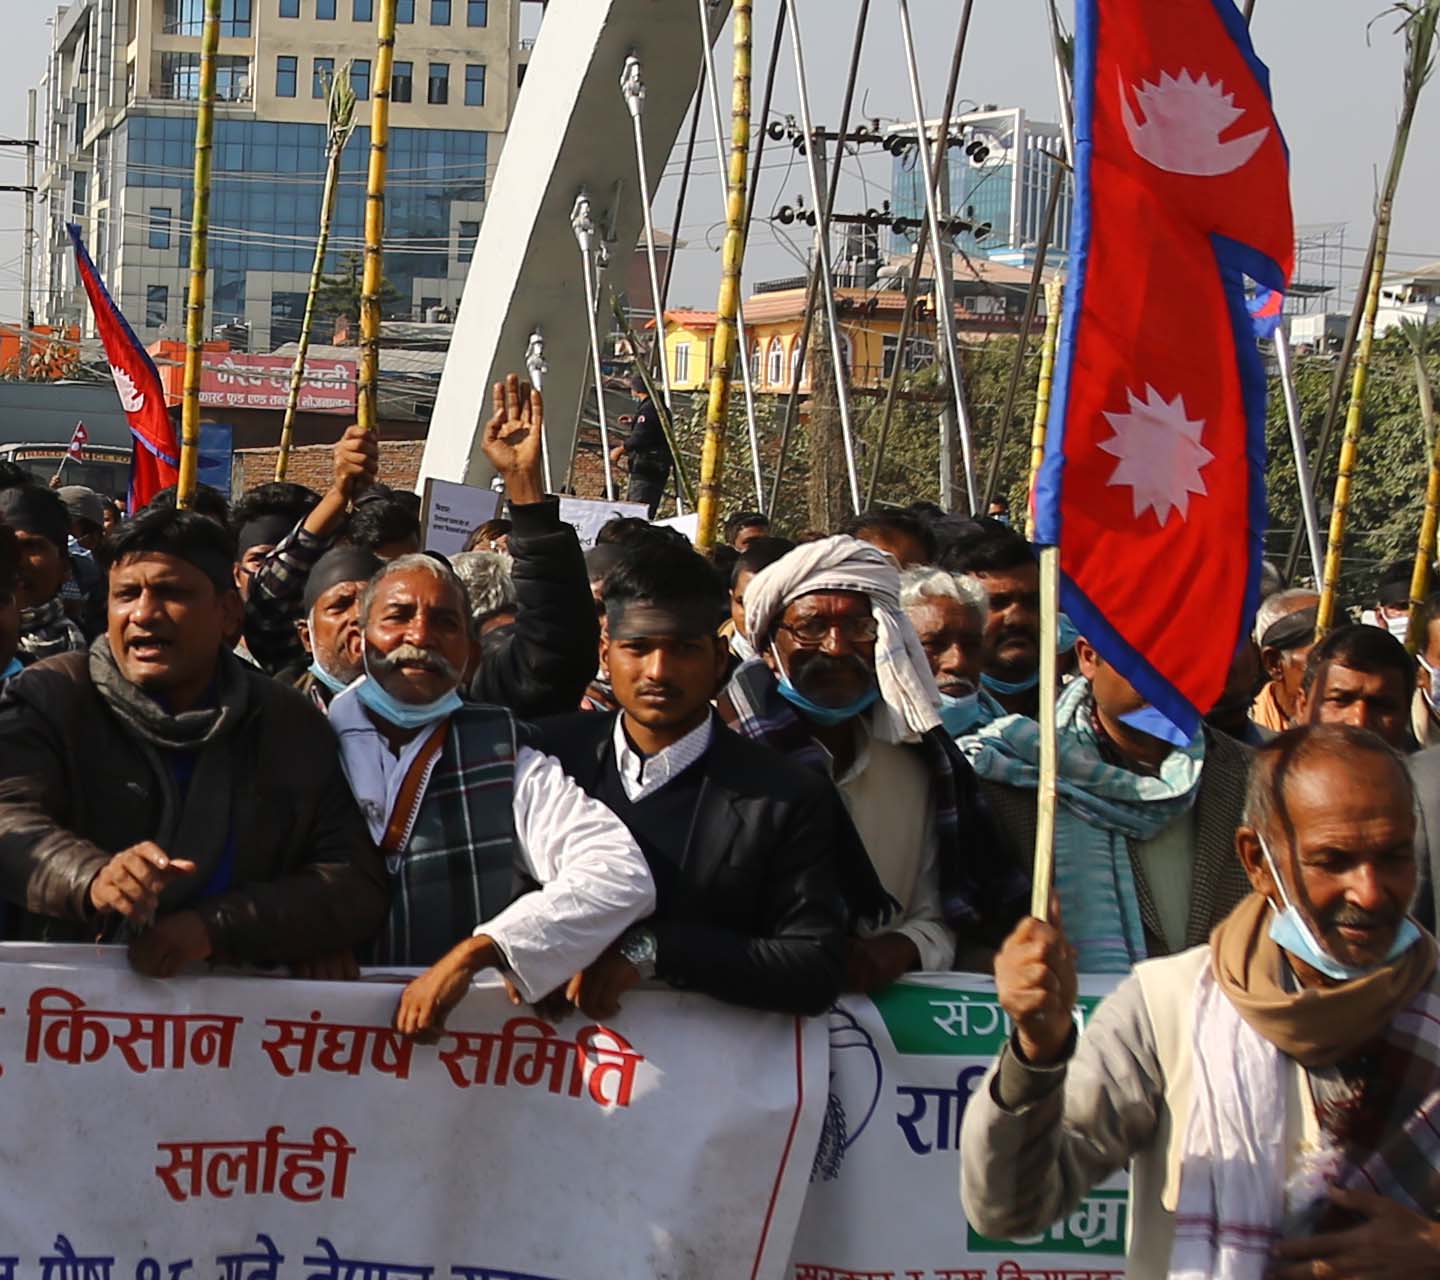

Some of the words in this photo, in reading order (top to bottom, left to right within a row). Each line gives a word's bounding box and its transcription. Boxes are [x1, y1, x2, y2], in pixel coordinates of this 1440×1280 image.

[25, 987, 243, 1073] किसान
[439, 1017, 645, 1108] समिति
[156, 1126, 357, 1202] सर्लाही
